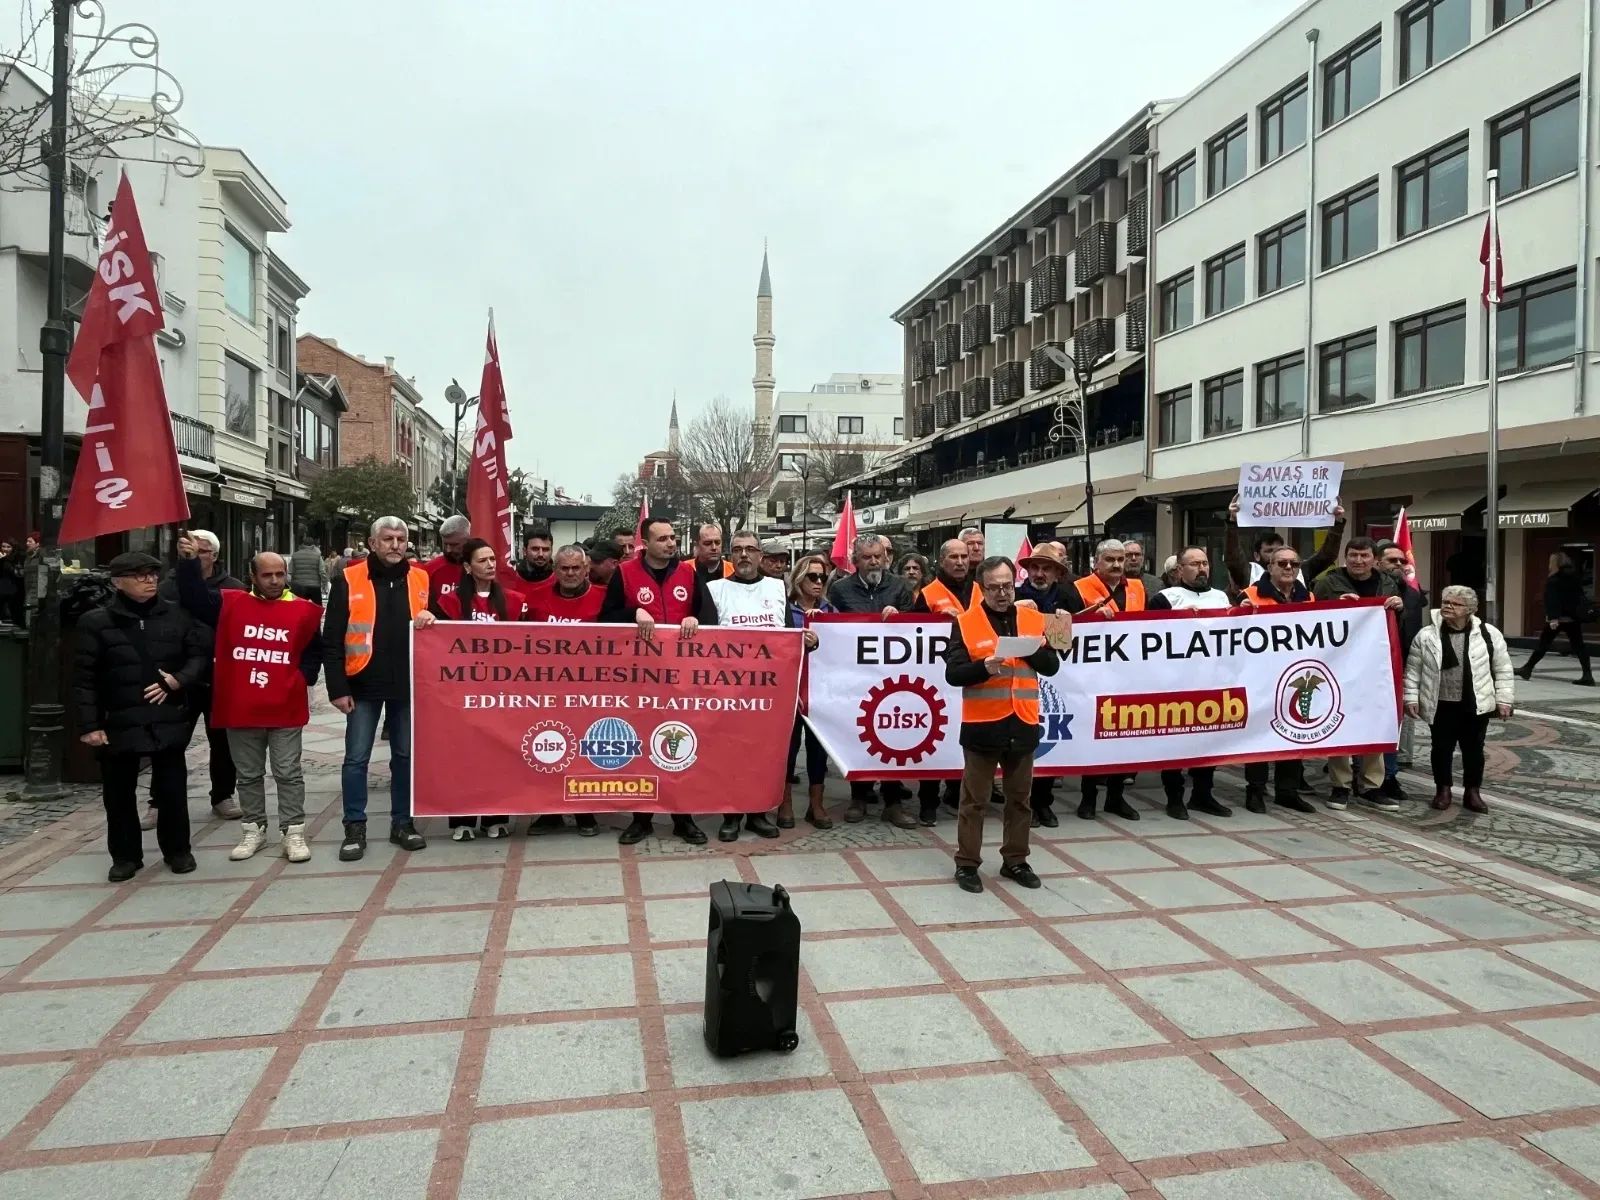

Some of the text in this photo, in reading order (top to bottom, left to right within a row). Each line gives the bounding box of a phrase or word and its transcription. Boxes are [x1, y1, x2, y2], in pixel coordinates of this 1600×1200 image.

[1248, 465, 1329, 483] SAVAŞ BİR
[1244, 482, 1327, 498] HALK SAĞLIĞI
[1252, 500, 1334, 518] SORUNUDUR
[1424, 518, 1447, 529] (ATM)
[1499, 513, 1550, 526] PTT (ATM)
[471, 609, 496, 622] İSK
[244, 624, 289, 642] DİSK
[1056, 633, 1130, 664] MEK
[1141, 620, 1349, 661] PLATFORMU
[233, 647, 290, 664] GENEL
[448, 635, 772, 660] ABD-İSRAİL'İN İRAN'A
[249, 668, 268, 688] İŞ
[439, 661, 778, 687] MÜDAHALESİNE HAYIR
[463, 692, 774, 711] EDİRNE EMEK PLATFORMU
[1100, 690, 1245, 730] tmmob
[877, 706, 928, 729] DİSK
[1120, 728, 1156, 737] MÜHENDİS
[1191, 724, 1220, 732] ODALARI
[1274, 719, 1288, 735] TÜRK
[1290, 731, 1321, 740] TABİPLERİ
[535, 739, 564, 752] DİSK
[580, 740, 642, 757] KESK
[602, 758, 620, 767] 1995
[568, 778, 654, 793] tmmob
